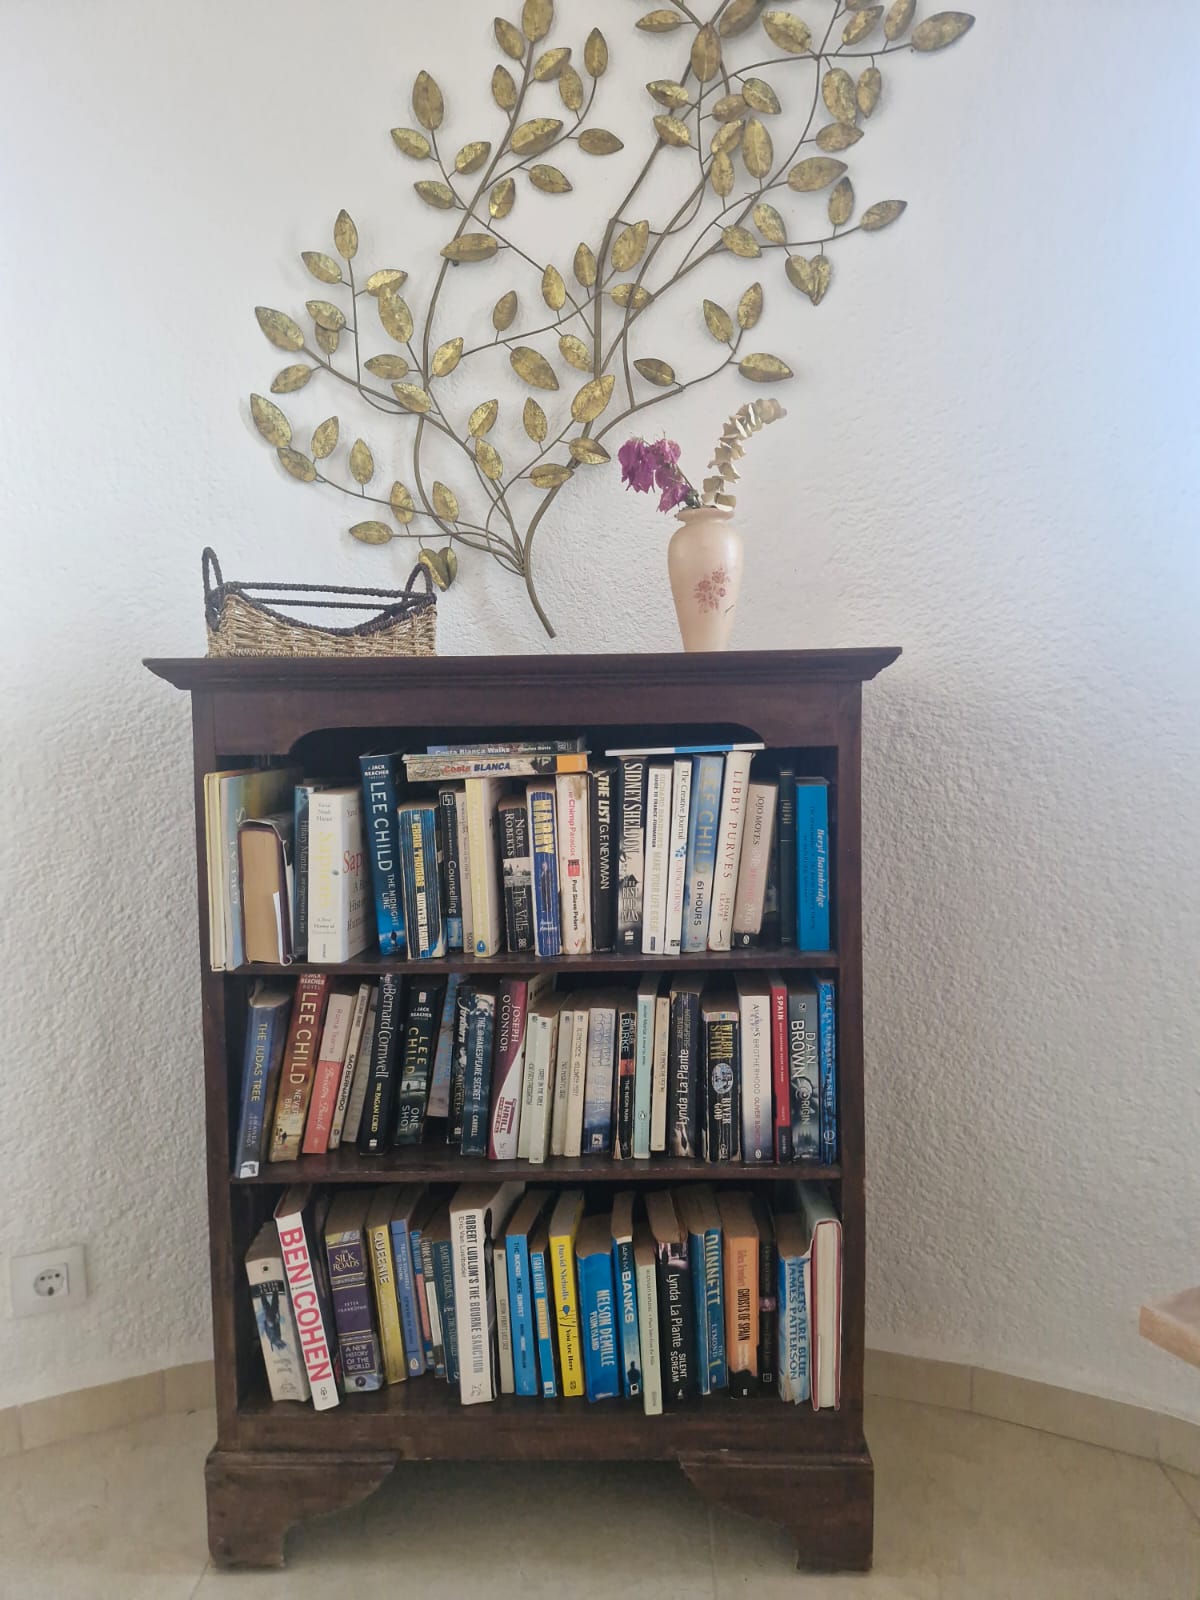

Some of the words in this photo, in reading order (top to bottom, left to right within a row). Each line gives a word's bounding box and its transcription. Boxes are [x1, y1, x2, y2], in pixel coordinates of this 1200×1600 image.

[444, 765, 471, 773] Costa
[473, 762, 511, 772] BLANCA
[623, 762, 642, 801] SIDNEY
[681, 768, 690, 783] The
[370, 781, 388, 814] LEE
[597, 775, 610, 798] THE
[679, 784, 689, 813] Creative
[702, 766, 718, 805] LEE
[729, 770, 743, 815] LIBBY
[567, 799, 576, 826] Chimp
[598, 800, 610, 824] LIST
[755, 795, 766, 815] JOJO
[411, 823, 423, 849] CRAIG
[504, 812, 516, 857] ROBERTS
[514, 818, 526, 849] NORA
[533, 800, 554, 855] HARRY
[622, 803, 641, 854] SHELDON
[678, 814, 688, 840] Journal
[752, 815, 763, 846] MOYES
[815, 828, 825, 854] Beryl
[374, 817, 393, 872] CHILD
[568, 827, 577, 857] Paradox
[695, 809, 714, 875] CHILD
[722, 823, 738, 879] PURVES
[314, 831, 336, 908] Sapiens
[413, 850, 425, 887] THOMAS
[599, 842, 610, 890] NEWMAN
[652, 851, 662, 873] MAKE
[386, 874, 396, 889] THE
[448, 860, 459, 915] Counselling
[512, 887, 526, 903] The
[622, 887, 639, 898] BEST
[651, 874, 661, 893] YOUR
[696, 880, 704, 890] 61
[815, 856, 826, 908] Bainbridge
[381, 892, 391, 910] LINE
[389, 890, 400, 926] MIDNIGHT
[416, 892, 428, 926] WINTER
[650, 894, 660, 909] LIFE
[693, 892, 704, 926] HOURS
[723, 897, 731, 922] HOME
[514, 910, 530, 932] Villa
[650, 910, 660, 932] GREAT
[418, 926, 430, 952] HAWK
[298, 992, 318, 1026] LEE
[380, 987, 397, 1030] Bernard
[477, 1016, 486, 1028] THE
[776, 994, 784, 1021] SPAIN
[257, 1022, 269, 1041] THE
[499, 994, 512, 1052] O'CONNOR
[511, 1004, 522, 1042] JOSEPH
[621, 1018, 630, 1053] BURKE
[375, 1030, 392, 1078] Cornwell
[406, 1027, 419, 1074] CHILD
[418, 1035, 429, 1065] LEE
[474, 1029, 485, 1075] SHAKESPEARE
[709, 1024, 722, 1060] SMITH
[721, 1023, 734, 1059] WILBUR
[791, 1019, 805, 1078] BROWN
[805, 1032, 816, 1064] DAN
[253, 1045, 265, 1077] JUDAS
[289, 1029, 312, 1084] CHILD
[676, 1049, 689, 1080] Plante
[753, 1038, 761, 1094] BROTHERHOOD
[250, 1079, 263, 1103] TREE
[338, 1070, 353, 1112] BERNARDO
[472, 1076, 482, 1100] SECRET
[676, 1082, 689, 1093] La
[373, 1092, 382, 1114] PAGAN
[499, 1101, 514, 1133] THRILL
[675, 1097, 690, 1126] Lynda
[713, 1102, 723, 1120] GOD
[722, 1097, 732, 1124] RIVER
[371, 1113, 381, 1133] LORD
[399, 1104, 410, 1132] SHOT
[409, 1107, 420, 1129] ONE
[458, 1216, 466, 1230] Eric
[465, 1215, 478, 1243] ROBERT
[279, 1226, 312, 1285] BEN
[332, 1260, 360, 1272] ROADS
[334, 1252, 356, 1263] SILK
[374, 1230, 391, 1285] QUEENIE
[397, 1254, 402, 1262] TO
[400, 1243, 408, 1262] TEACH
[439, 1244, 451, 1273] MARTHA
[466, 1246, 480, 1284] LUDLUM'S
[514, 1254, 522, 1277] BUENOS
[558, 1244, 568, 1267] David
[623, 1261, 629, 1270] M
[704, 1234, 721, 1305] DUNNETT
[788, 1263, 798, 1303] JAMES
[442, 1273, 454, 1299] GRIMES
[468, 1286, 480, 1300] THE
[515, 1278, 523, 1294] AIRES
[559, 1268, 569, 1301] Nicholls
[621, 1270, 634, 1323] BANKS
[665, 1274, 680, 1301] Lynda
[796, 1261, 807, 1313] VIOLETS
[516, 1294, 524, 1317] QUINTET
[596, 1289, 611, 1325] NELSON
[669, 1304, 682, 1316] La
[737, 1288, 750, 1312] GHOSTS
[469, 1301, 482, 1332] BOURNE
[589, 1310, 599, 1328] PLUM
[737, 1313, 750, 1321] OF
[797, 1317, 807, 1334] ARE
[293, 1290, 332, 1383] COHEN
[565, 1328, 574, 1341] You
[590, 1329, 599, 1351] ISLAND
[671, 1318, 683, 1348] Plante
[737, 1322, 750, 1341] SPAIN
[789, 1307, 798, 1381] PATTERSON
[471, 1334, 484, 1373] SANCTION
[600, 1328, 615, 1367] DEMILLE
[798, 1346, 807, 1378] BLUE
[347, 1362, 370, 1371] WORLD
[670, 1350, 679, 1382] SCREAM
[678, 1352, 687, 1378] SILENT
[709, 1358, 722, 1368] 1
